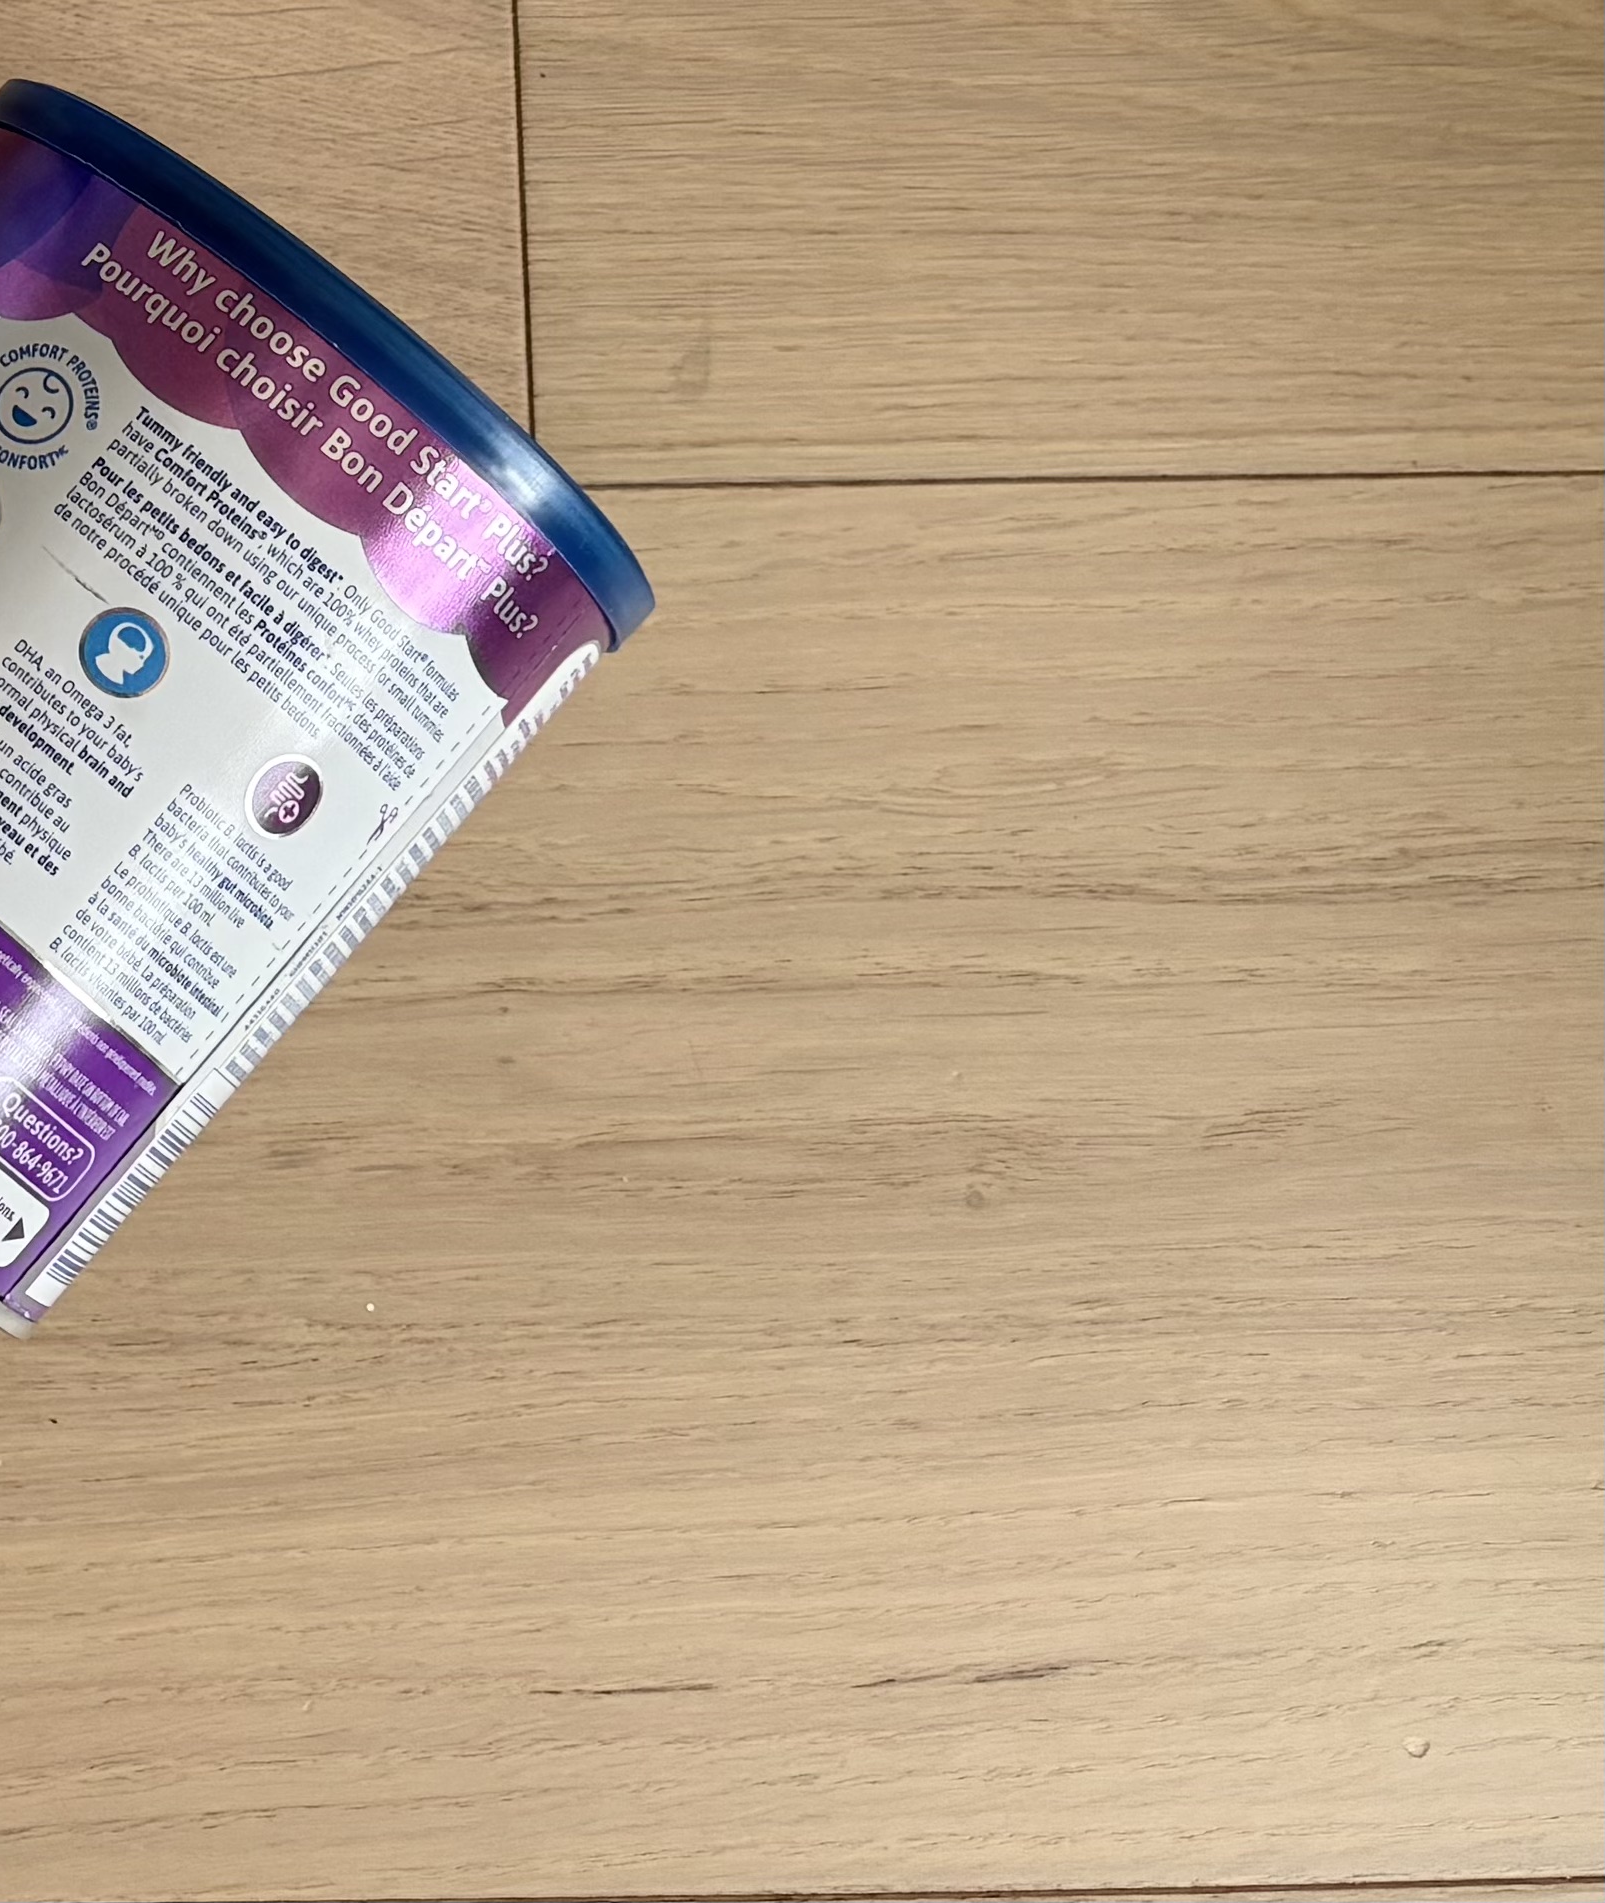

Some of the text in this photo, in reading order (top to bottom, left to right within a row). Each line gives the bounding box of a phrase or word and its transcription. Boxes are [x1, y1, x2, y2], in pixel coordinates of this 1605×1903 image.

[0, 343, 69, 367] COMFORT
[77, 238, 223, 356] Pourquoi
[214, 345, 323, 442] choisir
[318, 424, 383, 494] Bon
[478, 572, 541, 643] Plus?
[146, 231, 215, 302] Why
[212, 285, 328, 384] choose
[328, 371, 416, 456] Good
[480, 508, 551, 586] Plus?
[90, 454, 124, 489] Pour
[121, 479, 143, 504] les
[138, 498, 180, 535] petits
[177, 525, 227, 574] bedons
[224, 568, 243, 587] et
[237, 577, 275, 617] facile
[273, 609, 286, 625] à
[329, 660, 364, 700] Seules
[360, 690, 378, 714] les
[371, 706, 427, 761] préparations
[119, 419, 155, 454] have
[152, 445, 210, 497] Comfort
[265, 543, 308, 581] which
[301, 575, 325, 599] are
[321, 590, 357, 627] 100%
[352, 621, 383, 657] whey
[376, 646, 419, 689] proteins
[414, 678, 439, 706] that
[431, 698, 450, 719] are
[132, 404, 184, 456] Tummy
[179, 441, 233, 497] friendly
[229, 487, 260, 514] and
[255, 508, 287, 543] easy
[284, 530, 301, 552] to
[341, 582, 371, 619] Only
[368, 607, 401, 642] Good
[420, 657, 461, 703] formulas
[0, 654, 144, 783] contributes to your baby's
[11, 637, 133, 750] DHA, an Omega 3 fat,
[12, 753, 47, 786] acide
[42, 781, 72, 809] gras
[26, 706, 82, 754] physical
[75, 743, 110, 779] brain
[107, 774, 134, 798] and
